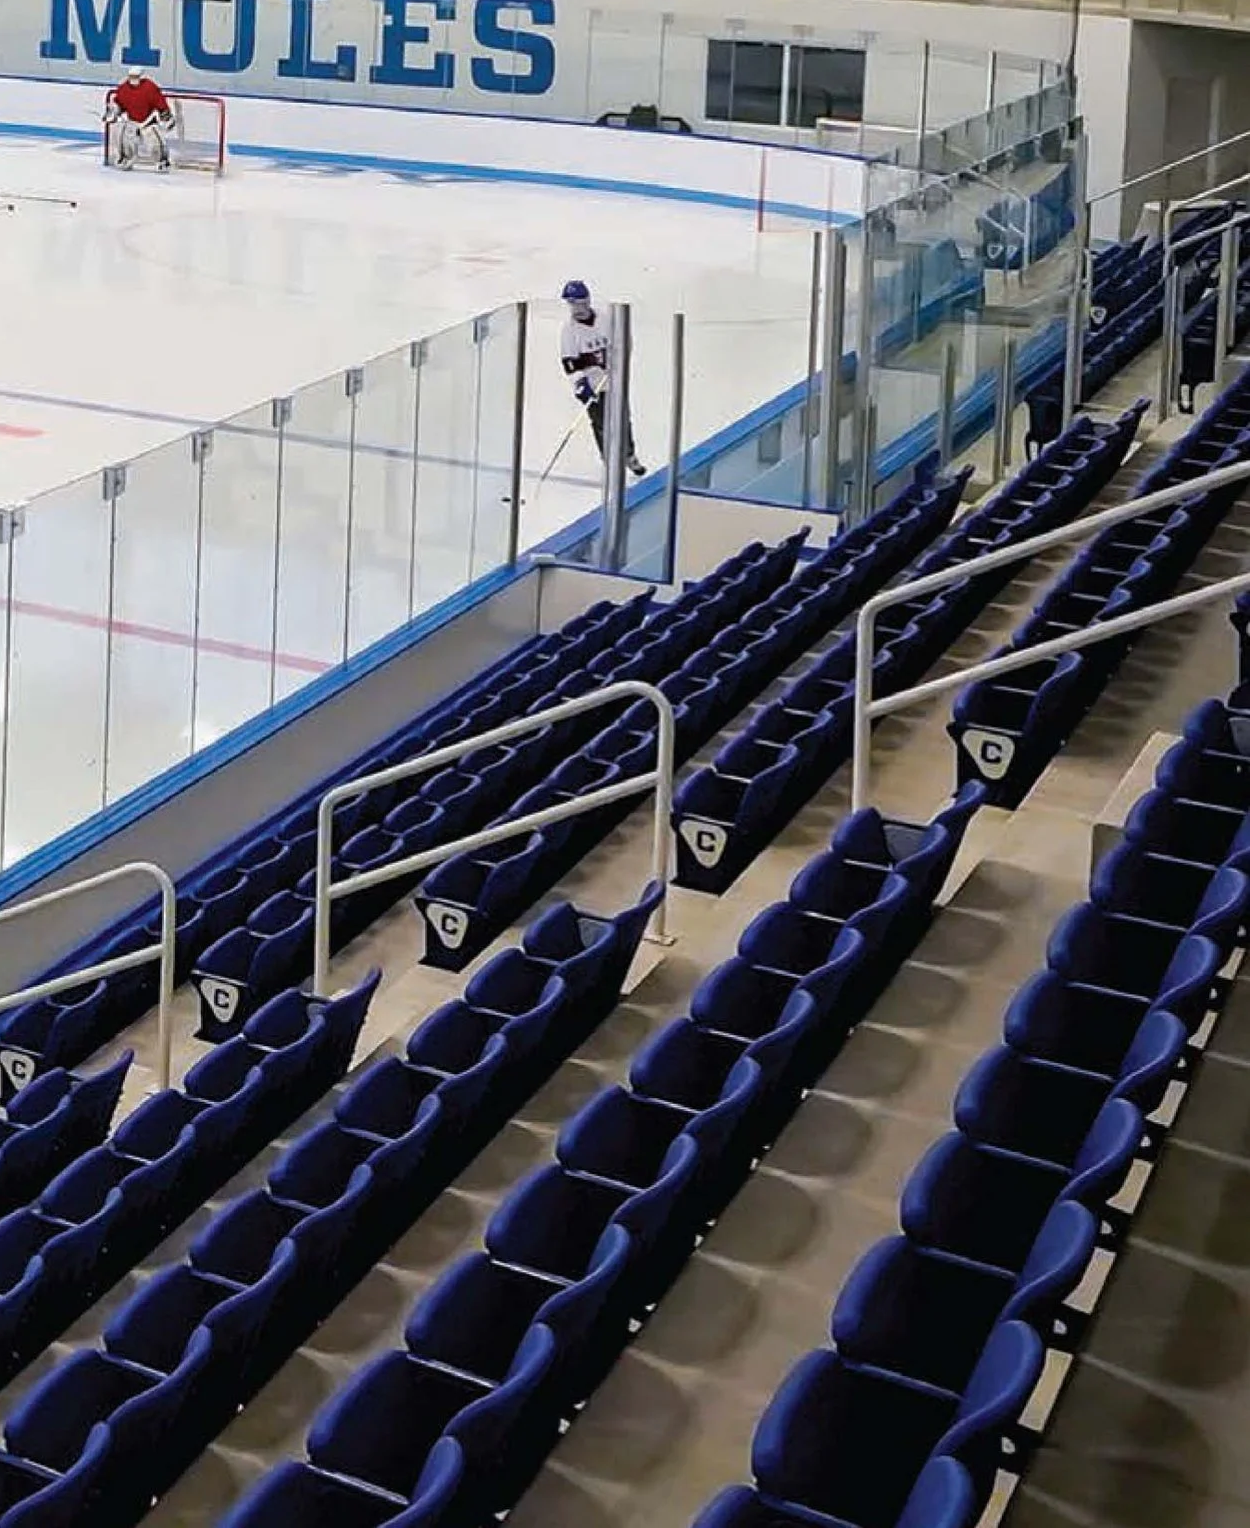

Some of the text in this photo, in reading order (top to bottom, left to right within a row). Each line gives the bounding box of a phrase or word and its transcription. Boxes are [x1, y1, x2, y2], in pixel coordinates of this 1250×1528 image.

[980, 740, 1003, 764] C
[697, 831, 716, 852] C
[441, 913, 459, 935] C
[213, 988, 230, 1009] C
[11, 1059, 26, 1079] C
